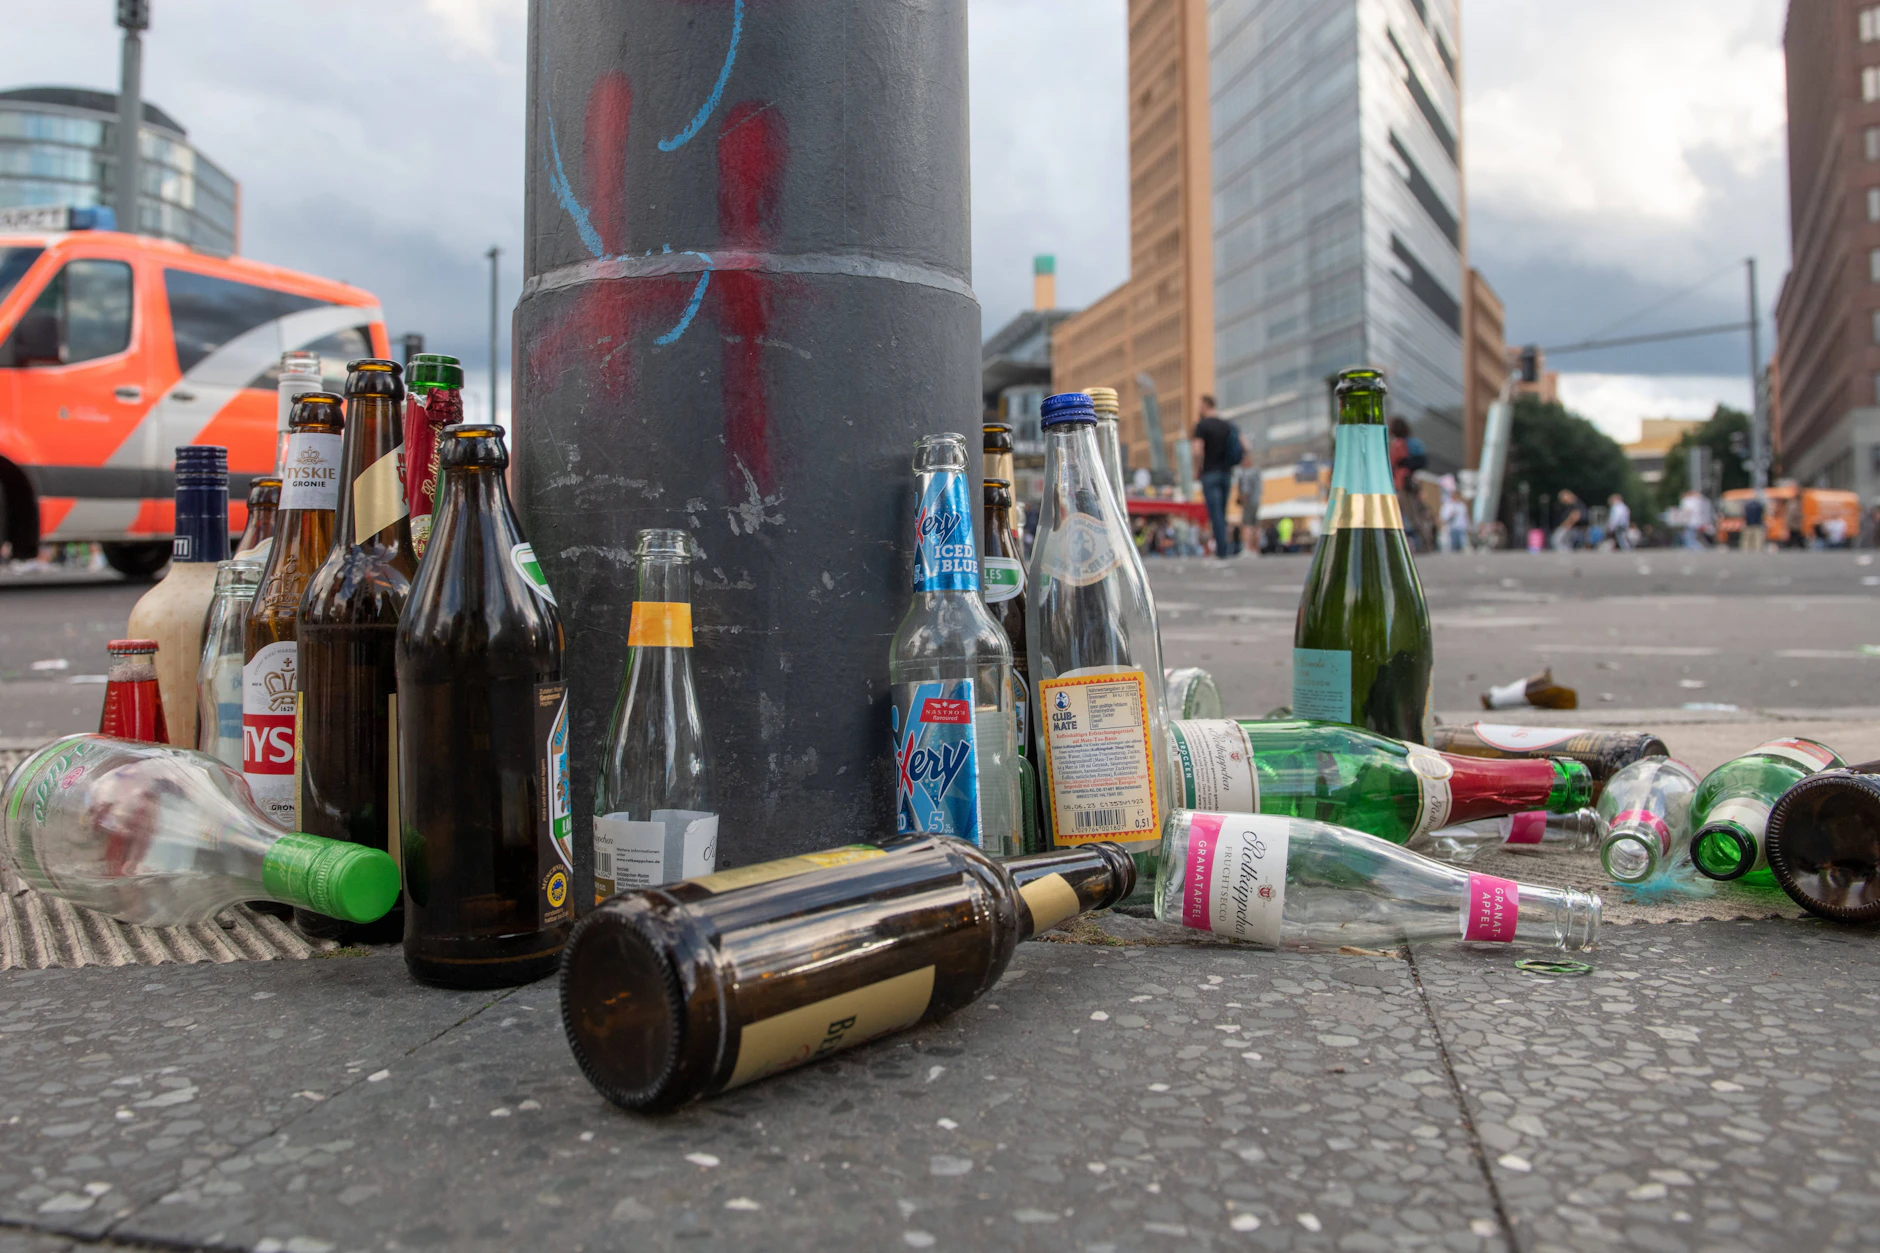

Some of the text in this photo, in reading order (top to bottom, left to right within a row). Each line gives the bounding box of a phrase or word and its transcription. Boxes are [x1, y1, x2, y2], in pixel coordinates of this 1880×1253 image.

[287, 467, 336, 479] TYSKIE
[934, 544, 973, 558] ICED
[941, 559, 979, 574] BLUE
[1052, 712, 1076, 722] CLUB-
[1053, 721, 1077, 731] MATE
[243, 726, 294, 764] TYS
[1178, 741, 1193, 779] TROCKEN
[1421, 795, 1442, 836] Rotkäpp
[1192, 840, 1207, 918] GRANATAPFEL
[1218, 846, 1233, 922] FRUCHTSECCO
[1231, 830, 1267, 935] Rotkäppchen
[1480, 891, 1491, 929] APFEL
[1493, 887, 1504, 938] GRANAT-
